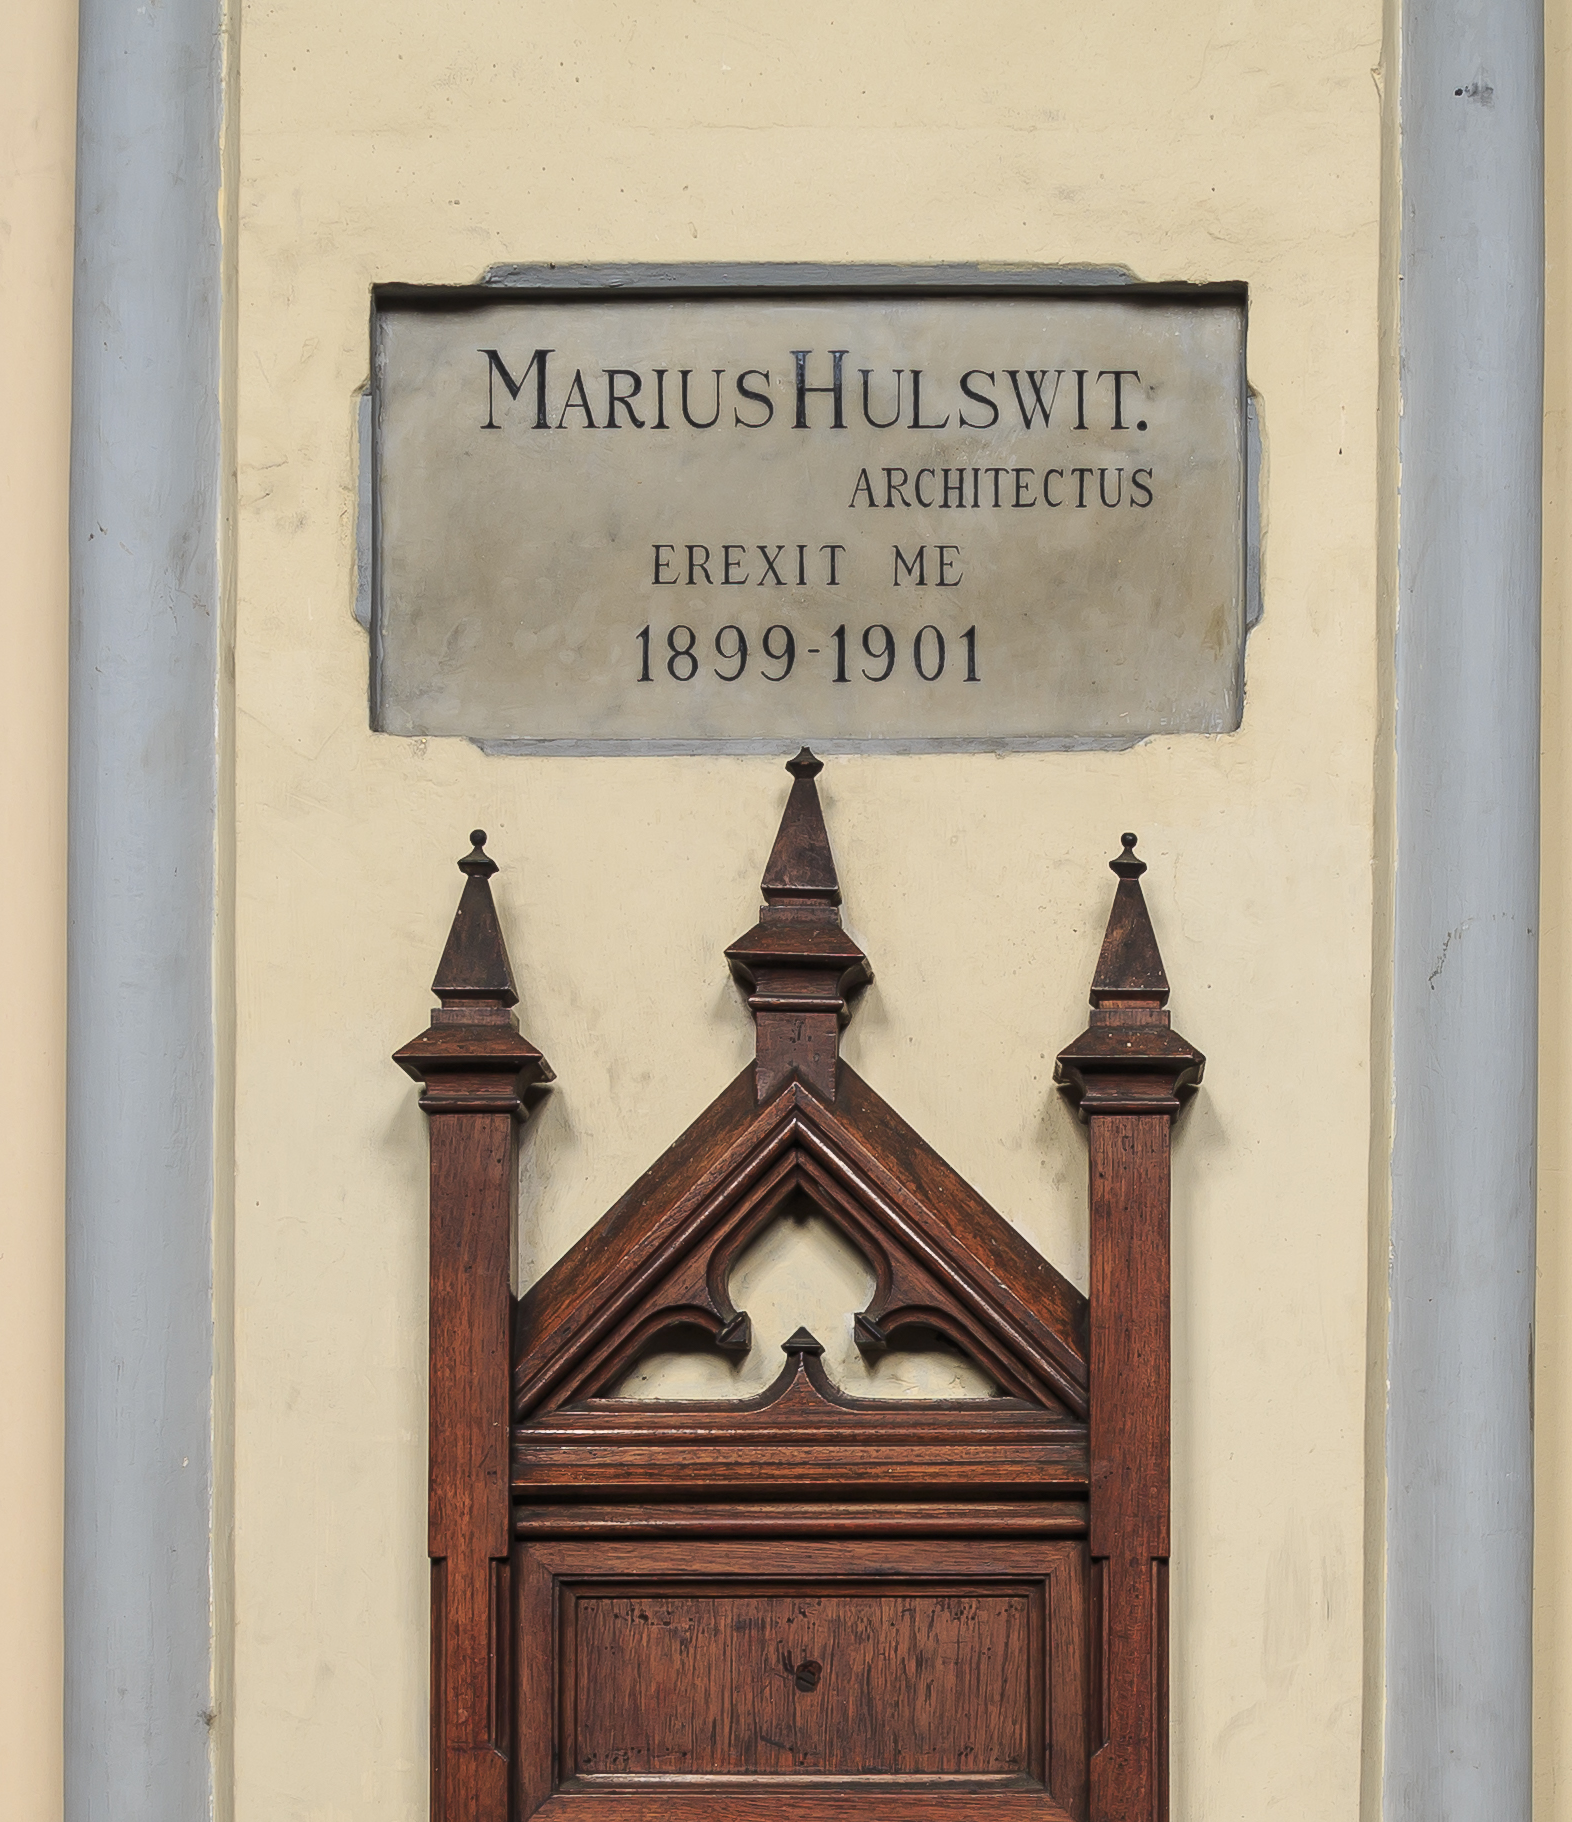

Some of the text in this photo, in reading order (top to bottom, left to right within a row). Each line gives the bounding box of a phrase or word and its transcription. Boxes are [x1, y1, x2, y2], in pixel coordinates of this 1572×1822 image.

[848, 466, 1155, 510] ARCHITECTUS
[651, 543, 965, 588] EREXIT ME
[635, 622, 982, 684] 1899-1901
